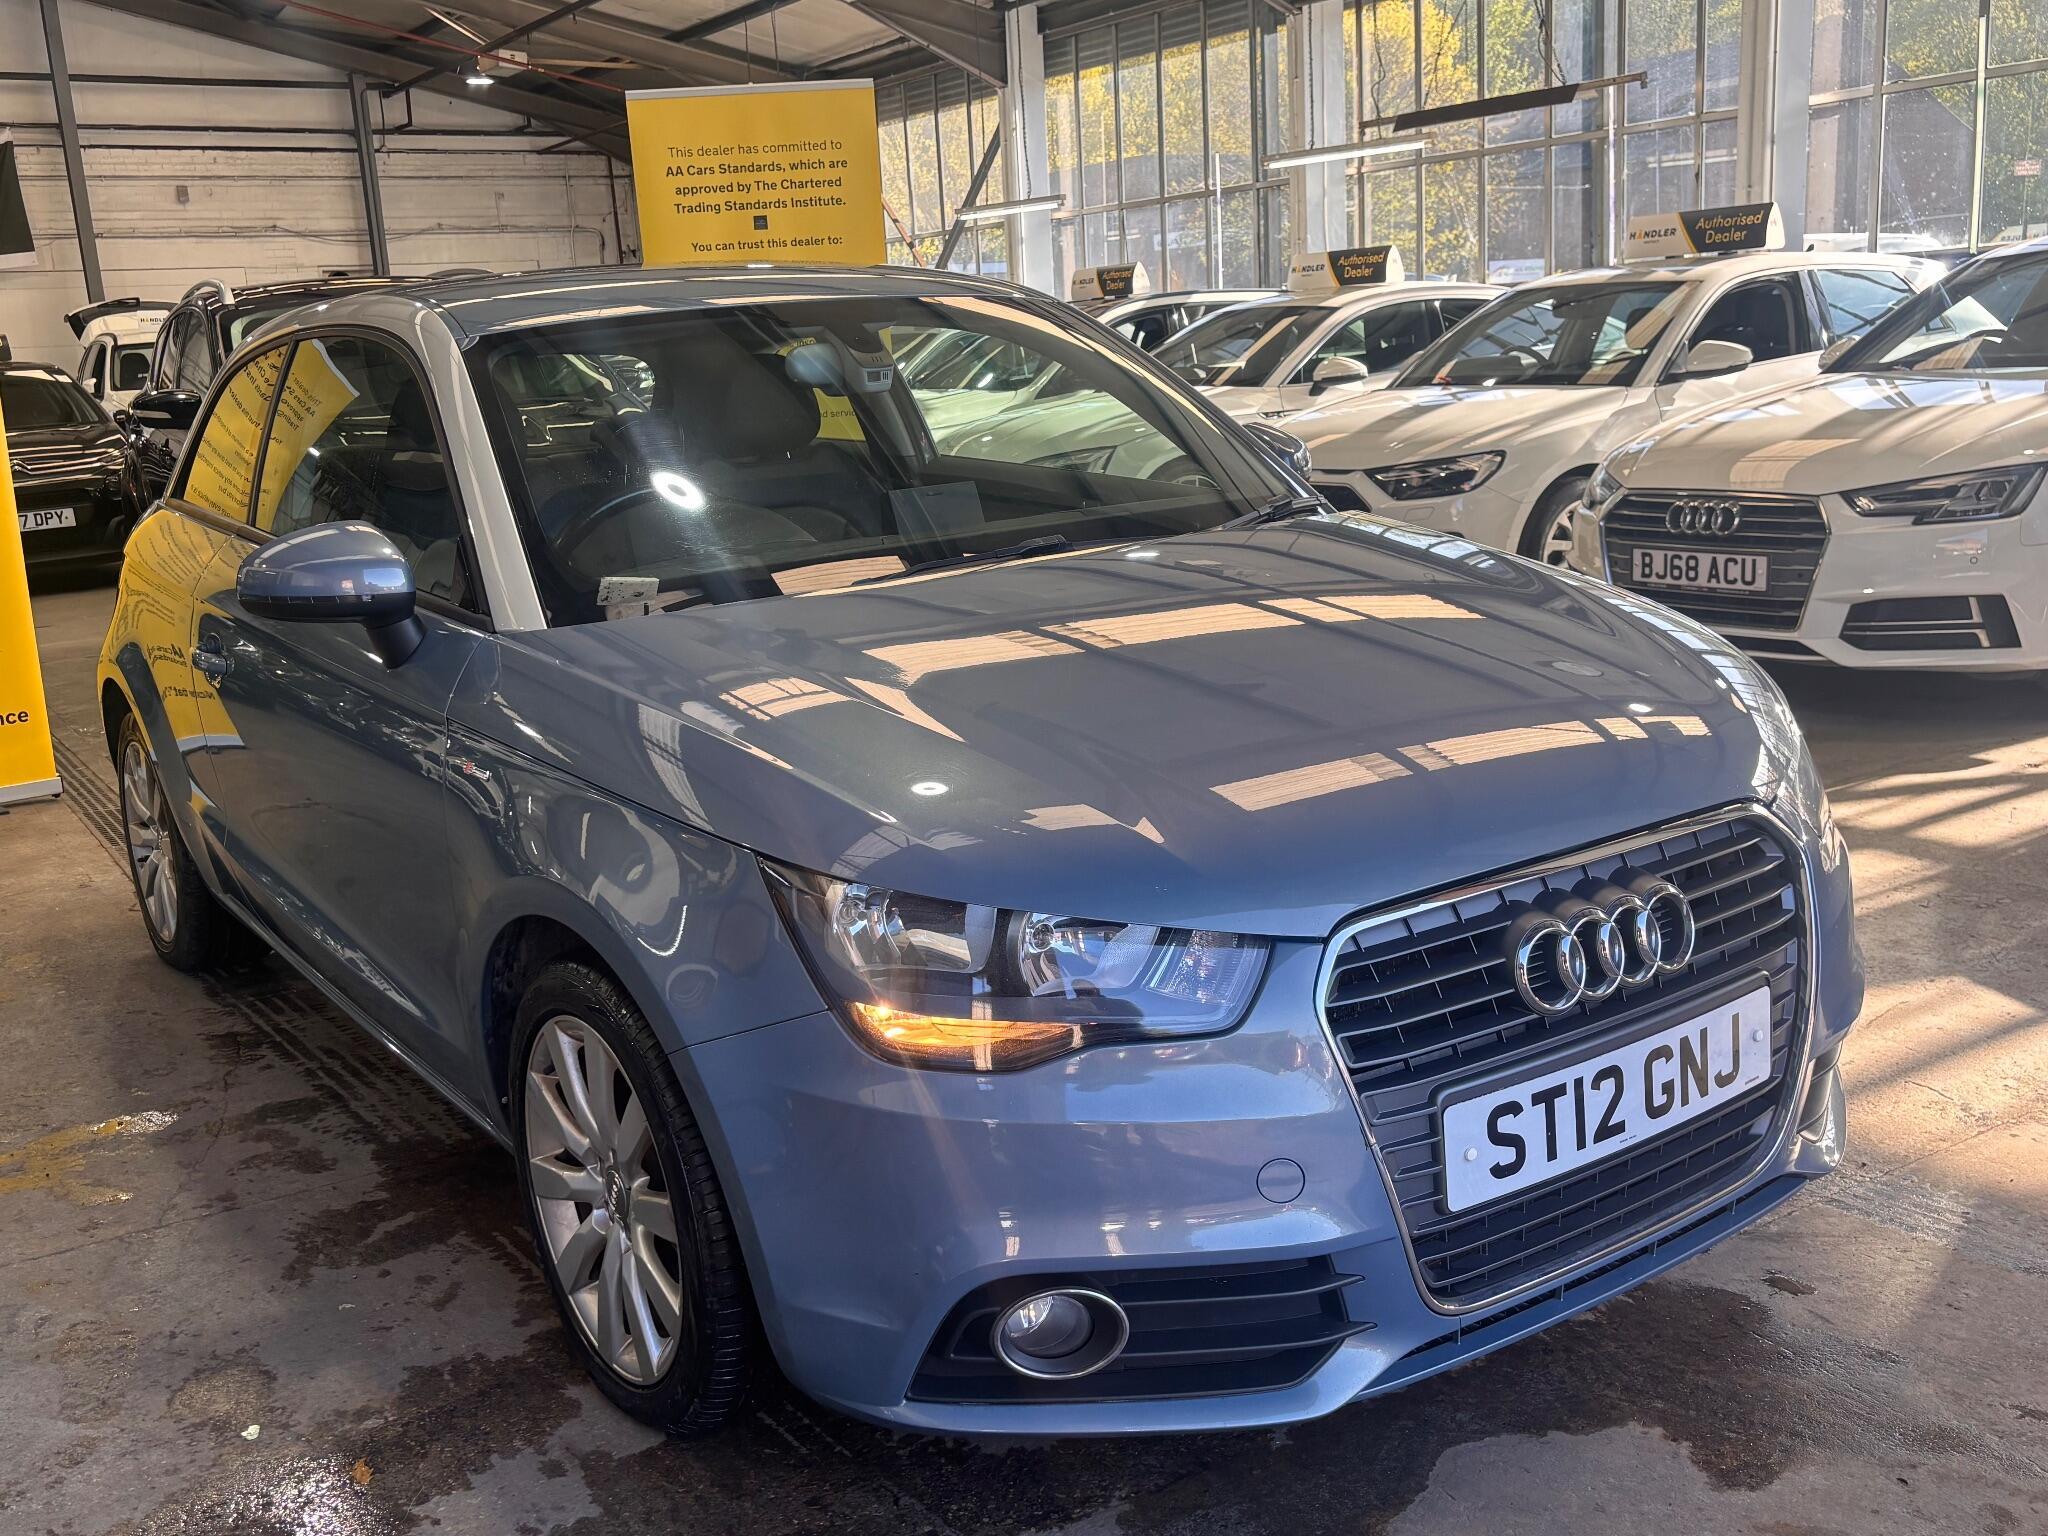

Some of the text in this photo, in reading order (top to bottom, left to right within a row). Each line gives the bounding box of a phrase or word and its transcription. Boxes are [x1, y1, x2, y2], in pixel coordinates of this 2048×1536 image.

[668, 139, 842, 159] This dealer has committed to
[666, 158, 848, 178] AA Cars Standards, which are
[675, 176, 842, 197] approved by The Chartered
[674, 195, 847, 215] Trading Standards Institute.
[1695, 210, 1765, 230] Authorised
[691, 235, 843, 252] You can trust this dealer to:
[1705, 230, 1748, 244] Dealer
[1338, 250, 1385, 266] Authorised
[1344, 266, 1374, 278] Dealer
[33, 510, 63, 527] DPY
[1640, 551, 1757, 586] BJ68 ACU
[1486, 1012, 1741, 1180] ST12 GNJ
